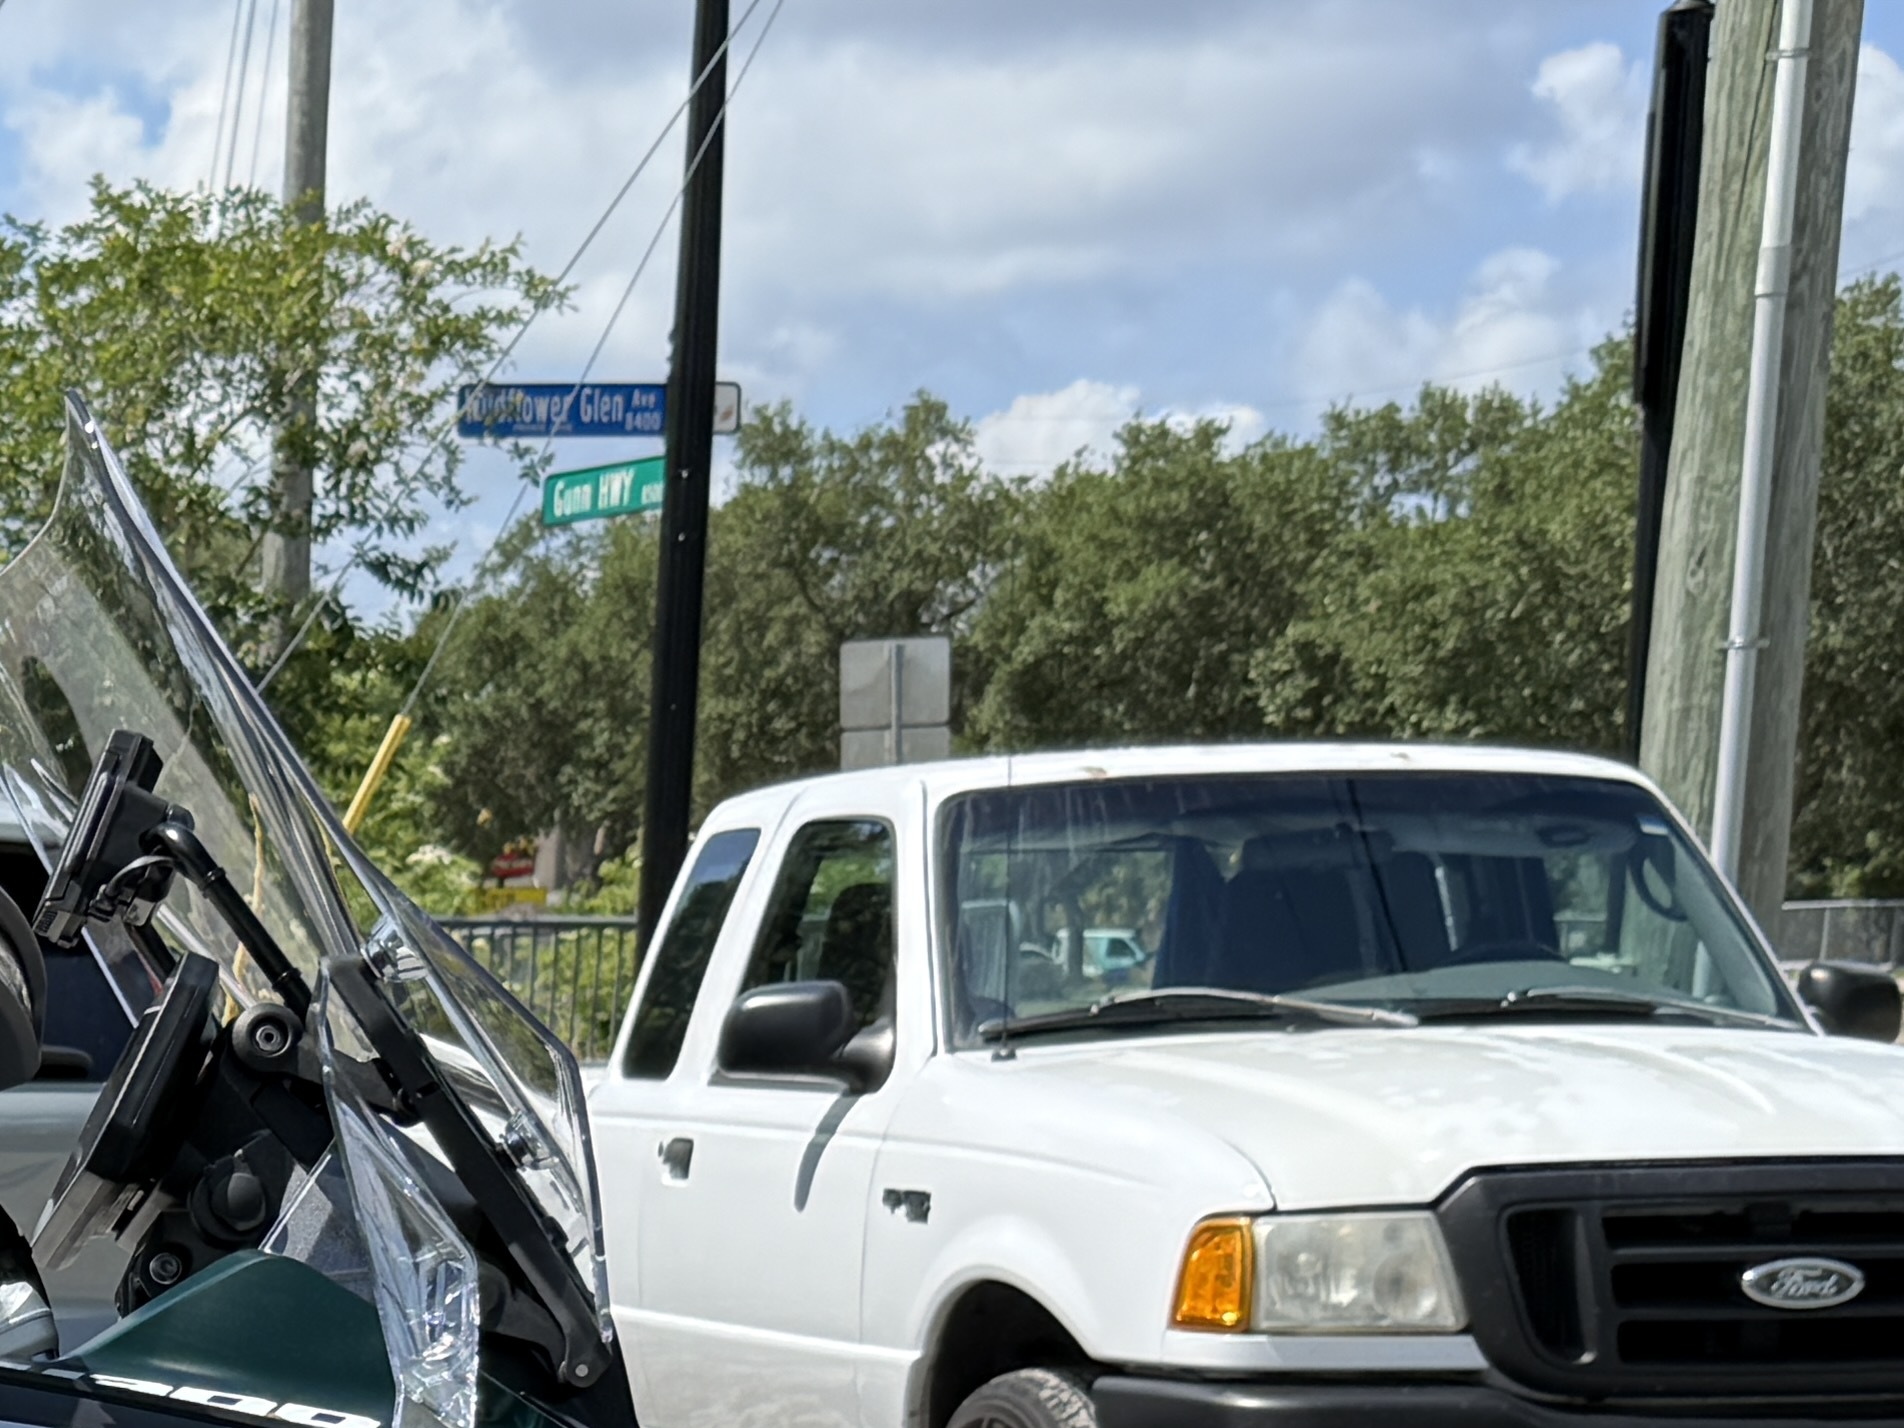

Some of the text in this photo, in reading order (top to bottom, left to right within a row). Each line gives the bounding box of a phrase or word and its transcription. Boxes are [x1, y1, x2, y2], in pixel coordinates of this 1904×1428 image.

[580, 386, 624, 424] Glen
[553, 480, 593, 518] Gunn
[597, 467, 637, 511] HWY
[1770, 1266, 1841, 1300] Ford
